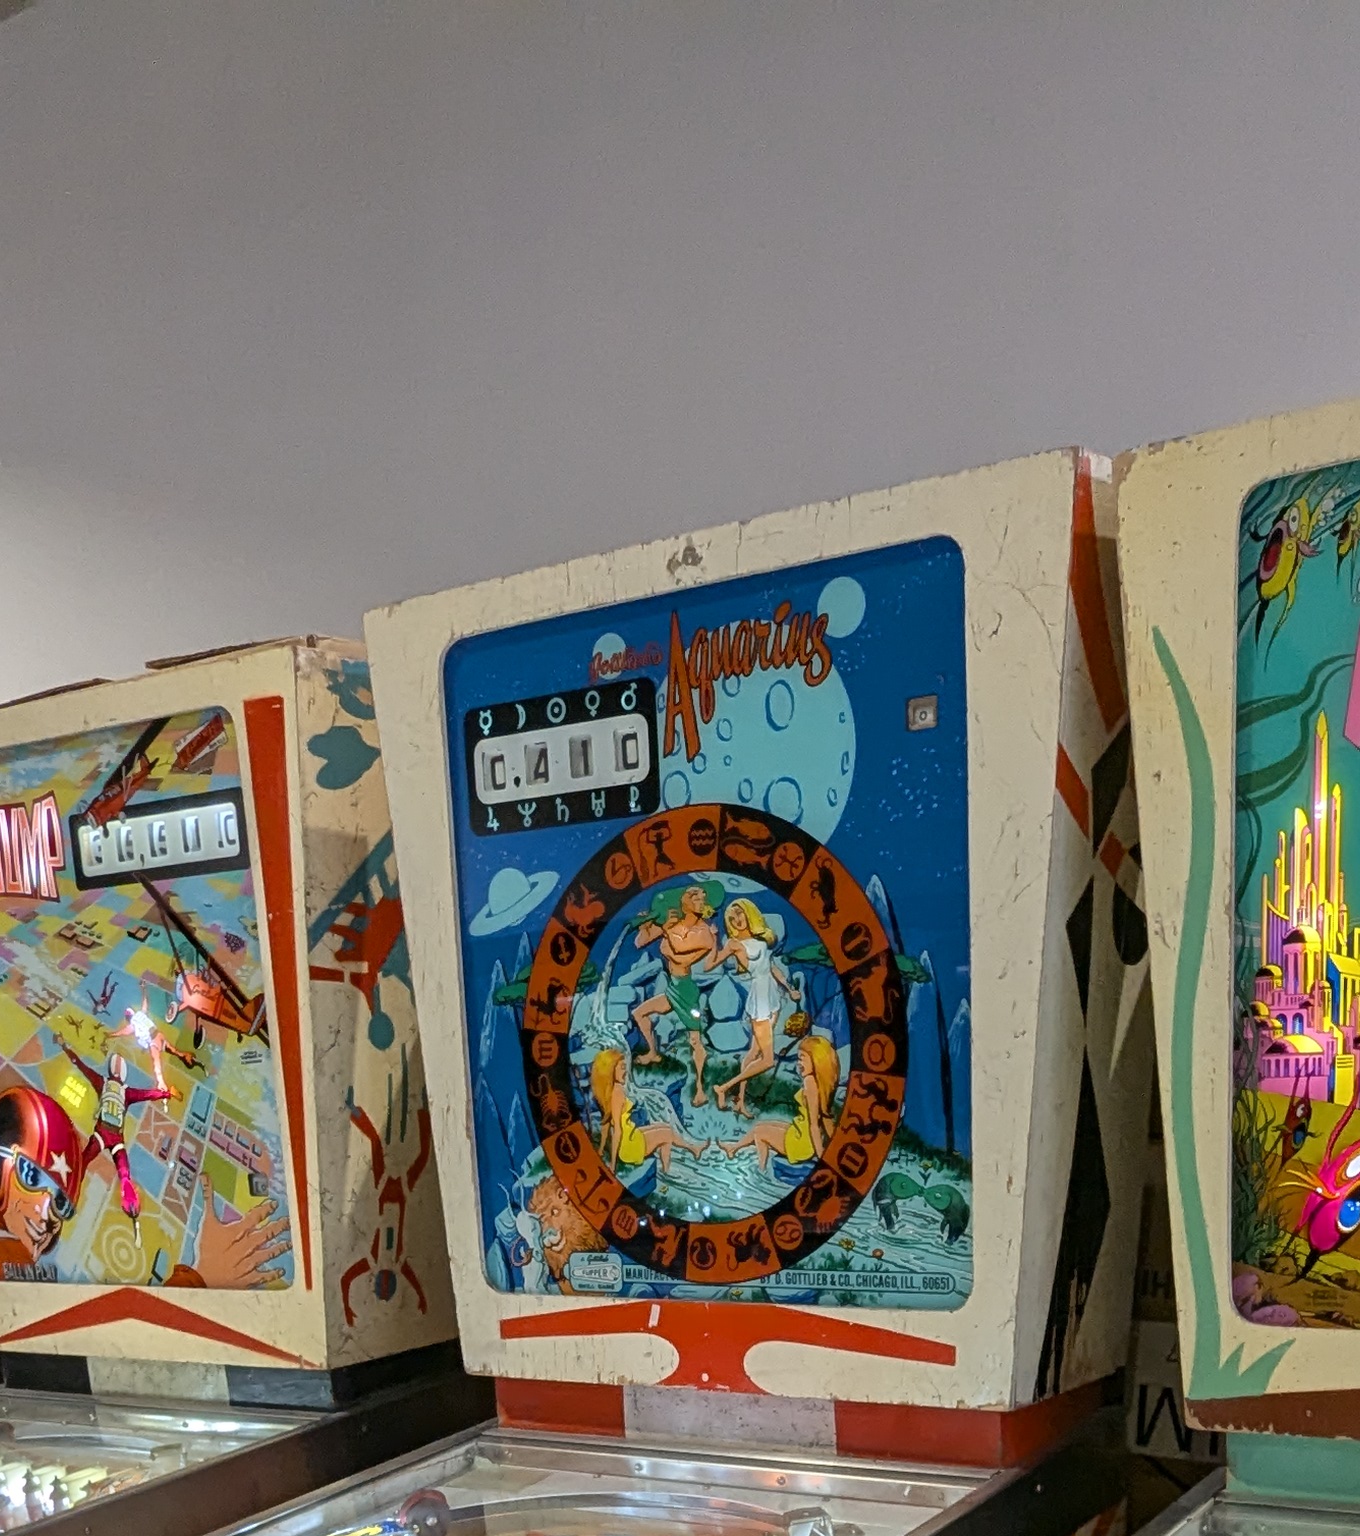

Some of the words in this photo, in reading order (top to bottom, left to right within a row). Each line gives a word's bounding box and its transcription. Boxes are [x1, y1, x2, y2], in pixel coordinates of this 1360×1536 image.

[663, 601, 832, 762] Aquarius
[784, 1273, 829, 1287] GOTTLIEB
[922, 1278, 951, 1291] 60651
